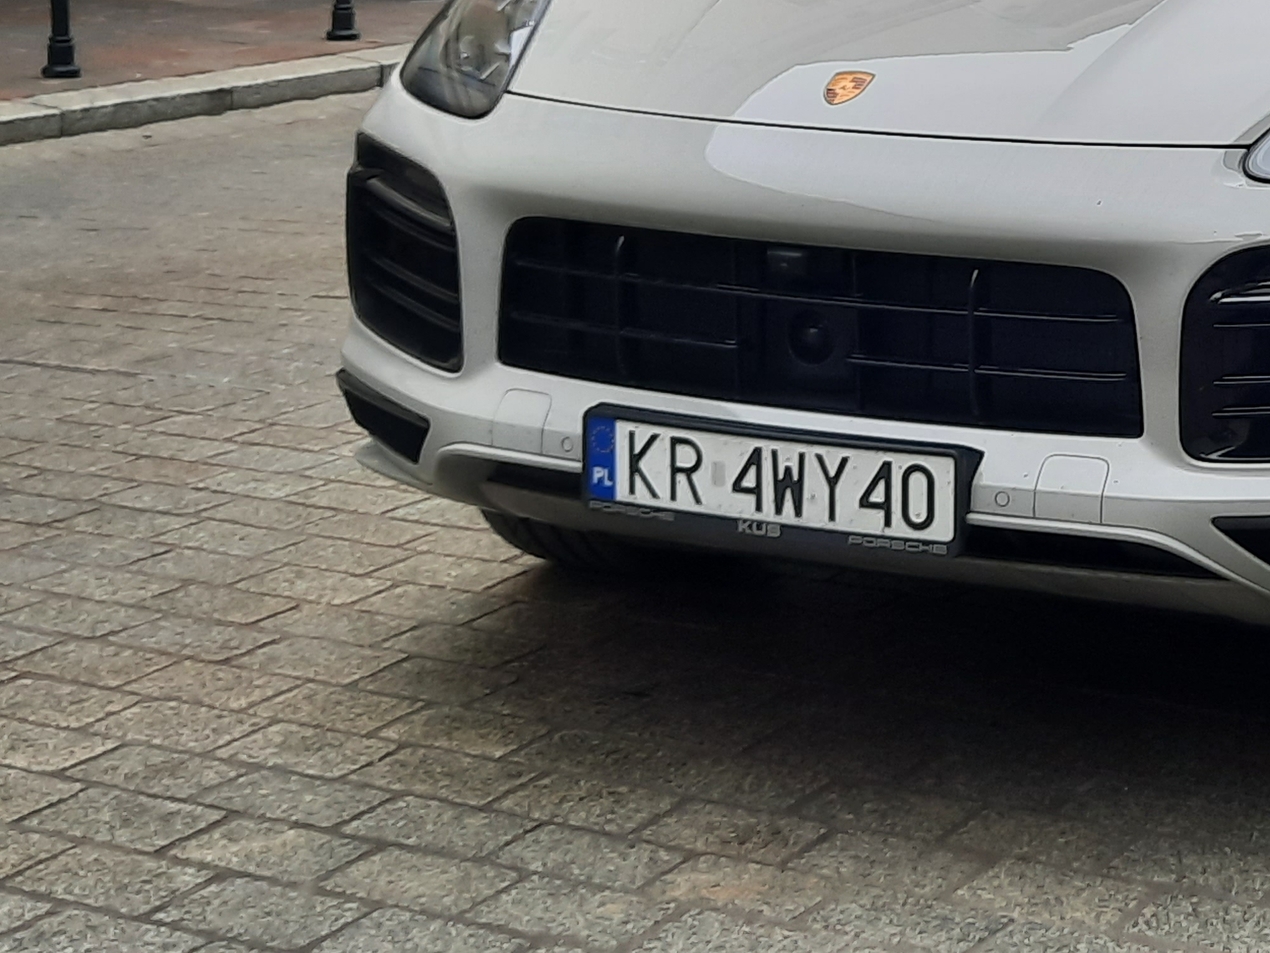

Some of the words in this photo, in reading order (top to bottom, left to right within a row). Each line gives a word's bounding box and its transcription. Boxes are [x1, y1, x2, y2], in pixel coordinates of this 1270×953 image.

[592, 466, 614, 487] PL
[628, 430, 704, 505] KR
[731, 446, 936, 531] 4WY40
[848, 534, 948, 556] PORSCHE
